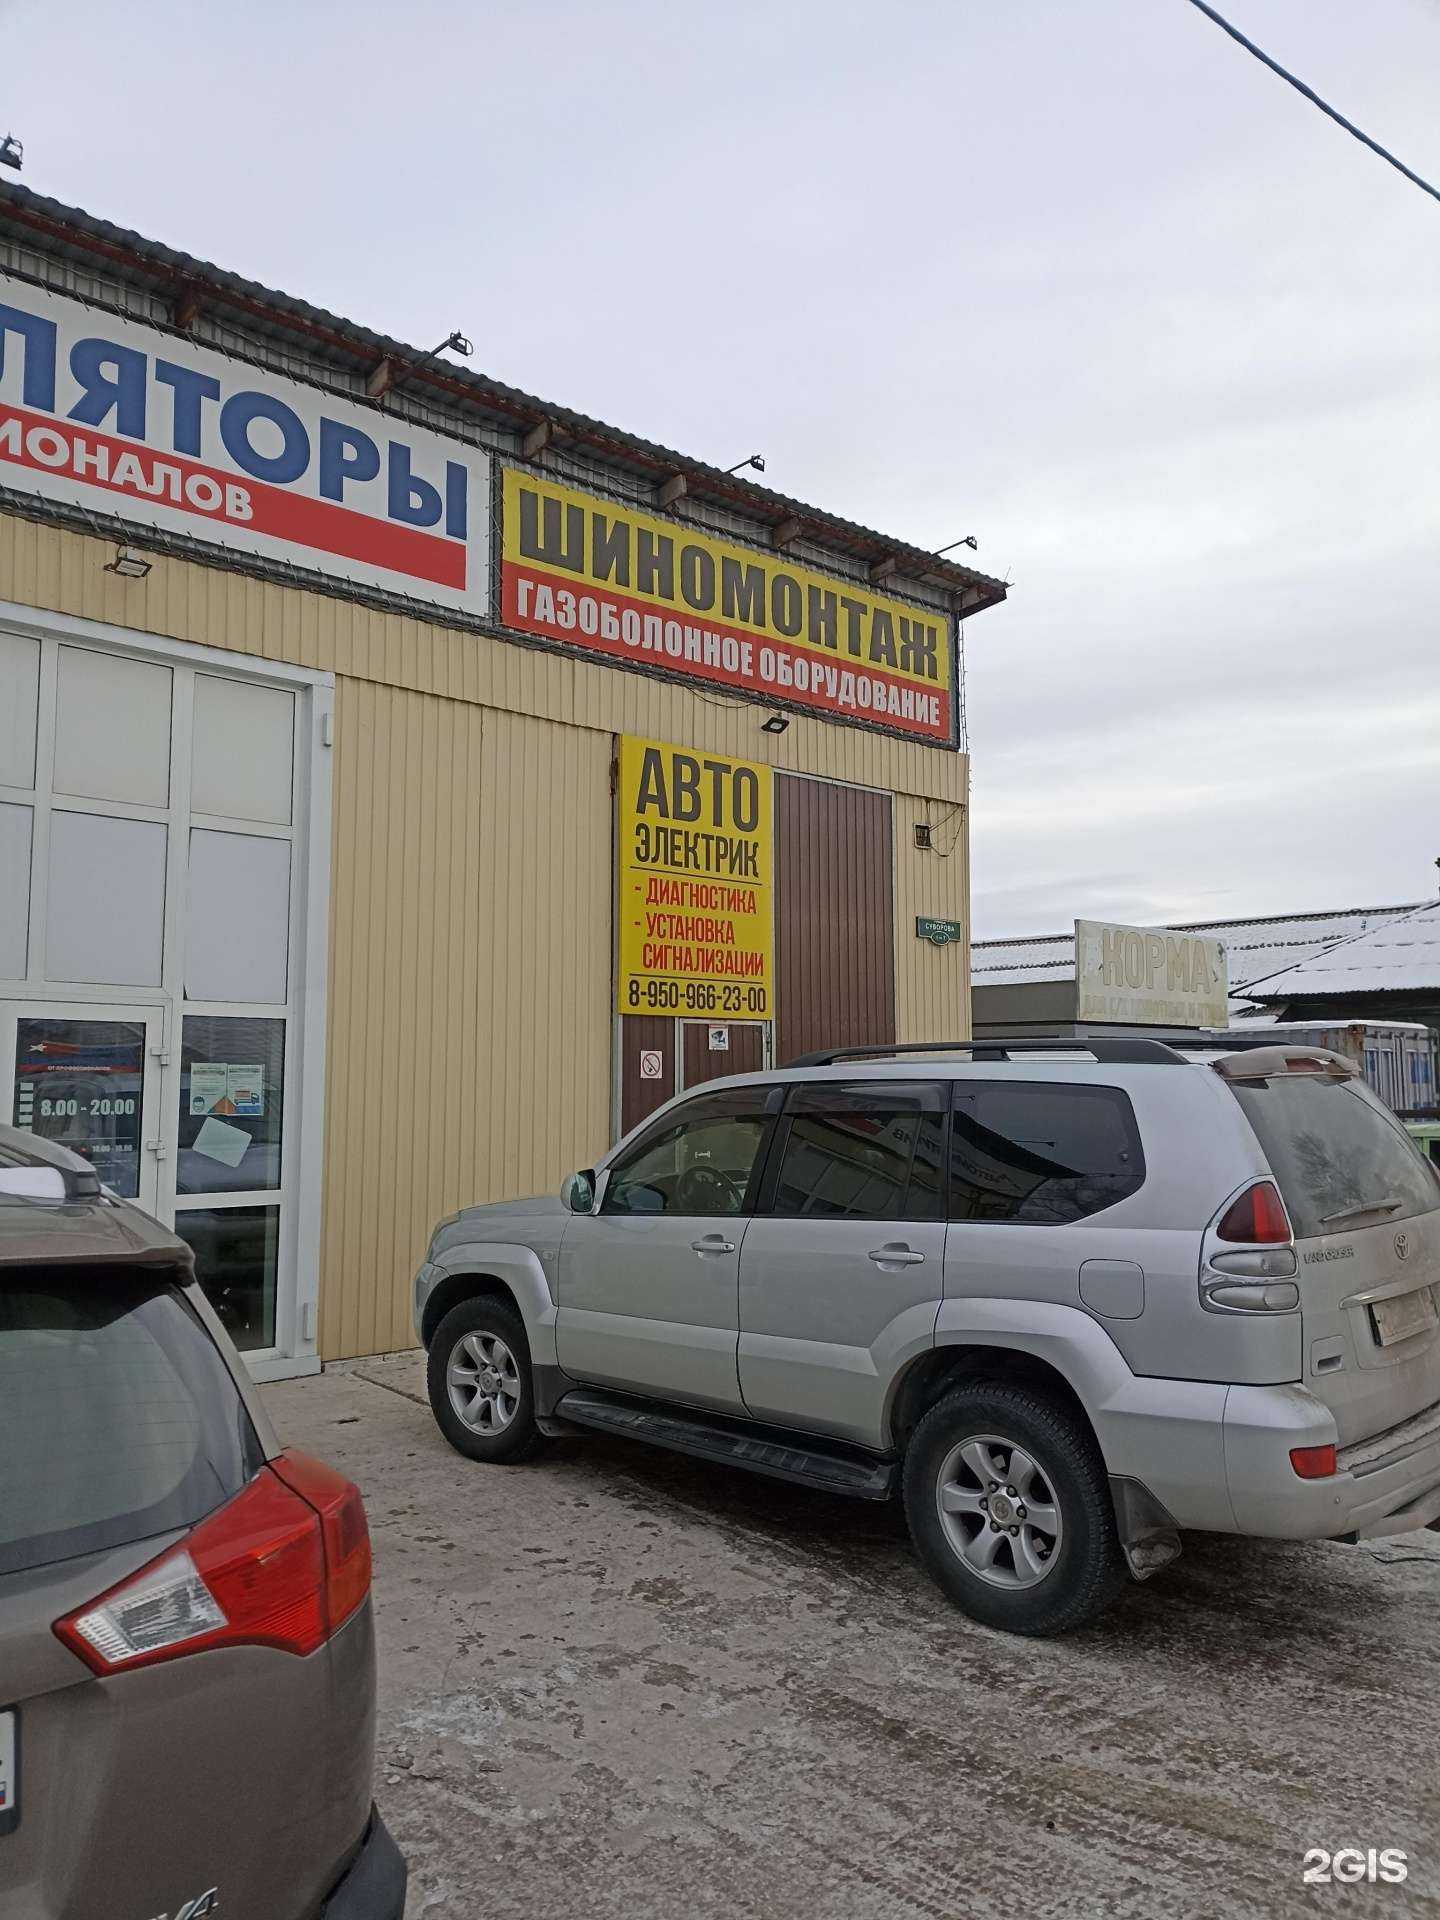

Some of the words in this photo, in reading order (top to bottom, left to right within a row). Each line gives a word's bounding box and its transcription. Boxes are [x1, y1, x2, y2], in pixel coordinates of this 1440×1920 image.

[0, 304, 467, 540] ЛЯТОРЫ
[519, 488, 938, 680] ШИНОМОНТАЖ
[517, 579, 753, 677] ГАЗОБОЛОННОЕ
[760, 647, 940, 727] ОБОРУДОВАНИЕ
[635, 747, 759, 833] АВТО
[635, 823, 760, 878] ЭЛЕКТРИК
[645, 877, 757, 915] ДИАГНОСТИКА
[645, 912, 735, 945] УСТАНОВКА
[642, 943, 764, 977] СИГНАЛИЗАЦИИ
[1102, 928, 1211, 994] КОРМА
[629, 980, 766, 1013] 8-950-966-23-00
[40, 1099, 78, 1117] 8.00
[90, 1098, 135, 1116] 20.00
